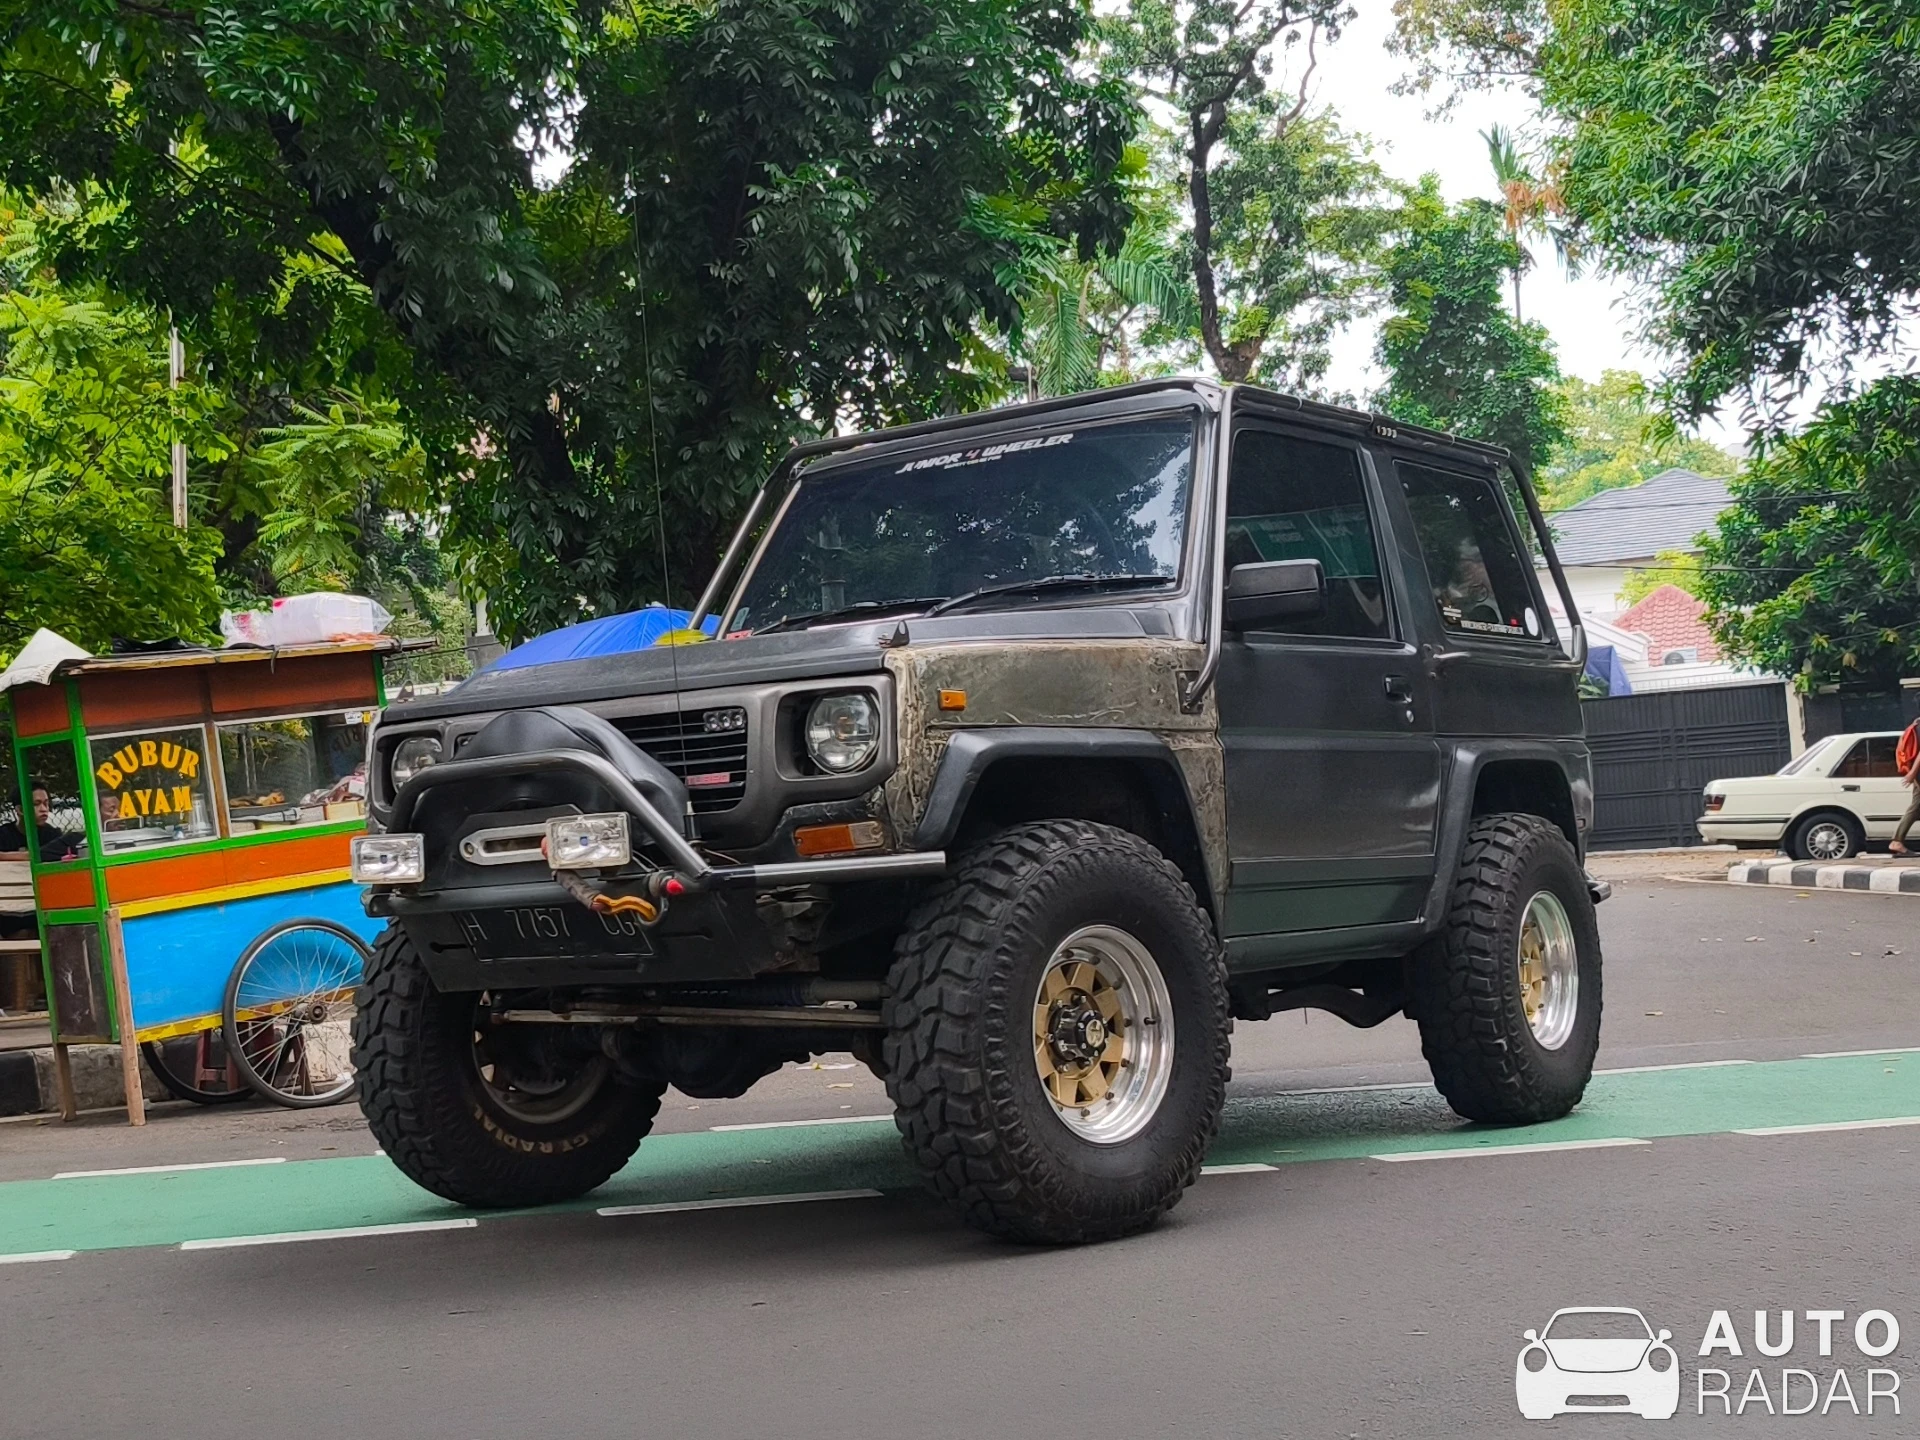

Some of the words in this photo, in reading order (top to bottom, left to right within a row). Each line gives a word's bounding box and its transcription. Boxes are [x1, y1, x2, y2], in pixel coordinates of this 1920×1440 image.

[894, 451, 963, 475] JUNIOR
[965, 449, 981, 460] 4
[981, 433, 1074, 457] WHEELER
[96, 740, 200, 790] BUBUR
[119, 786, 194, 818] AYAM
[504, 908, 571, 938] 7757
[473, 1102, 554, 1154] RADIAL
